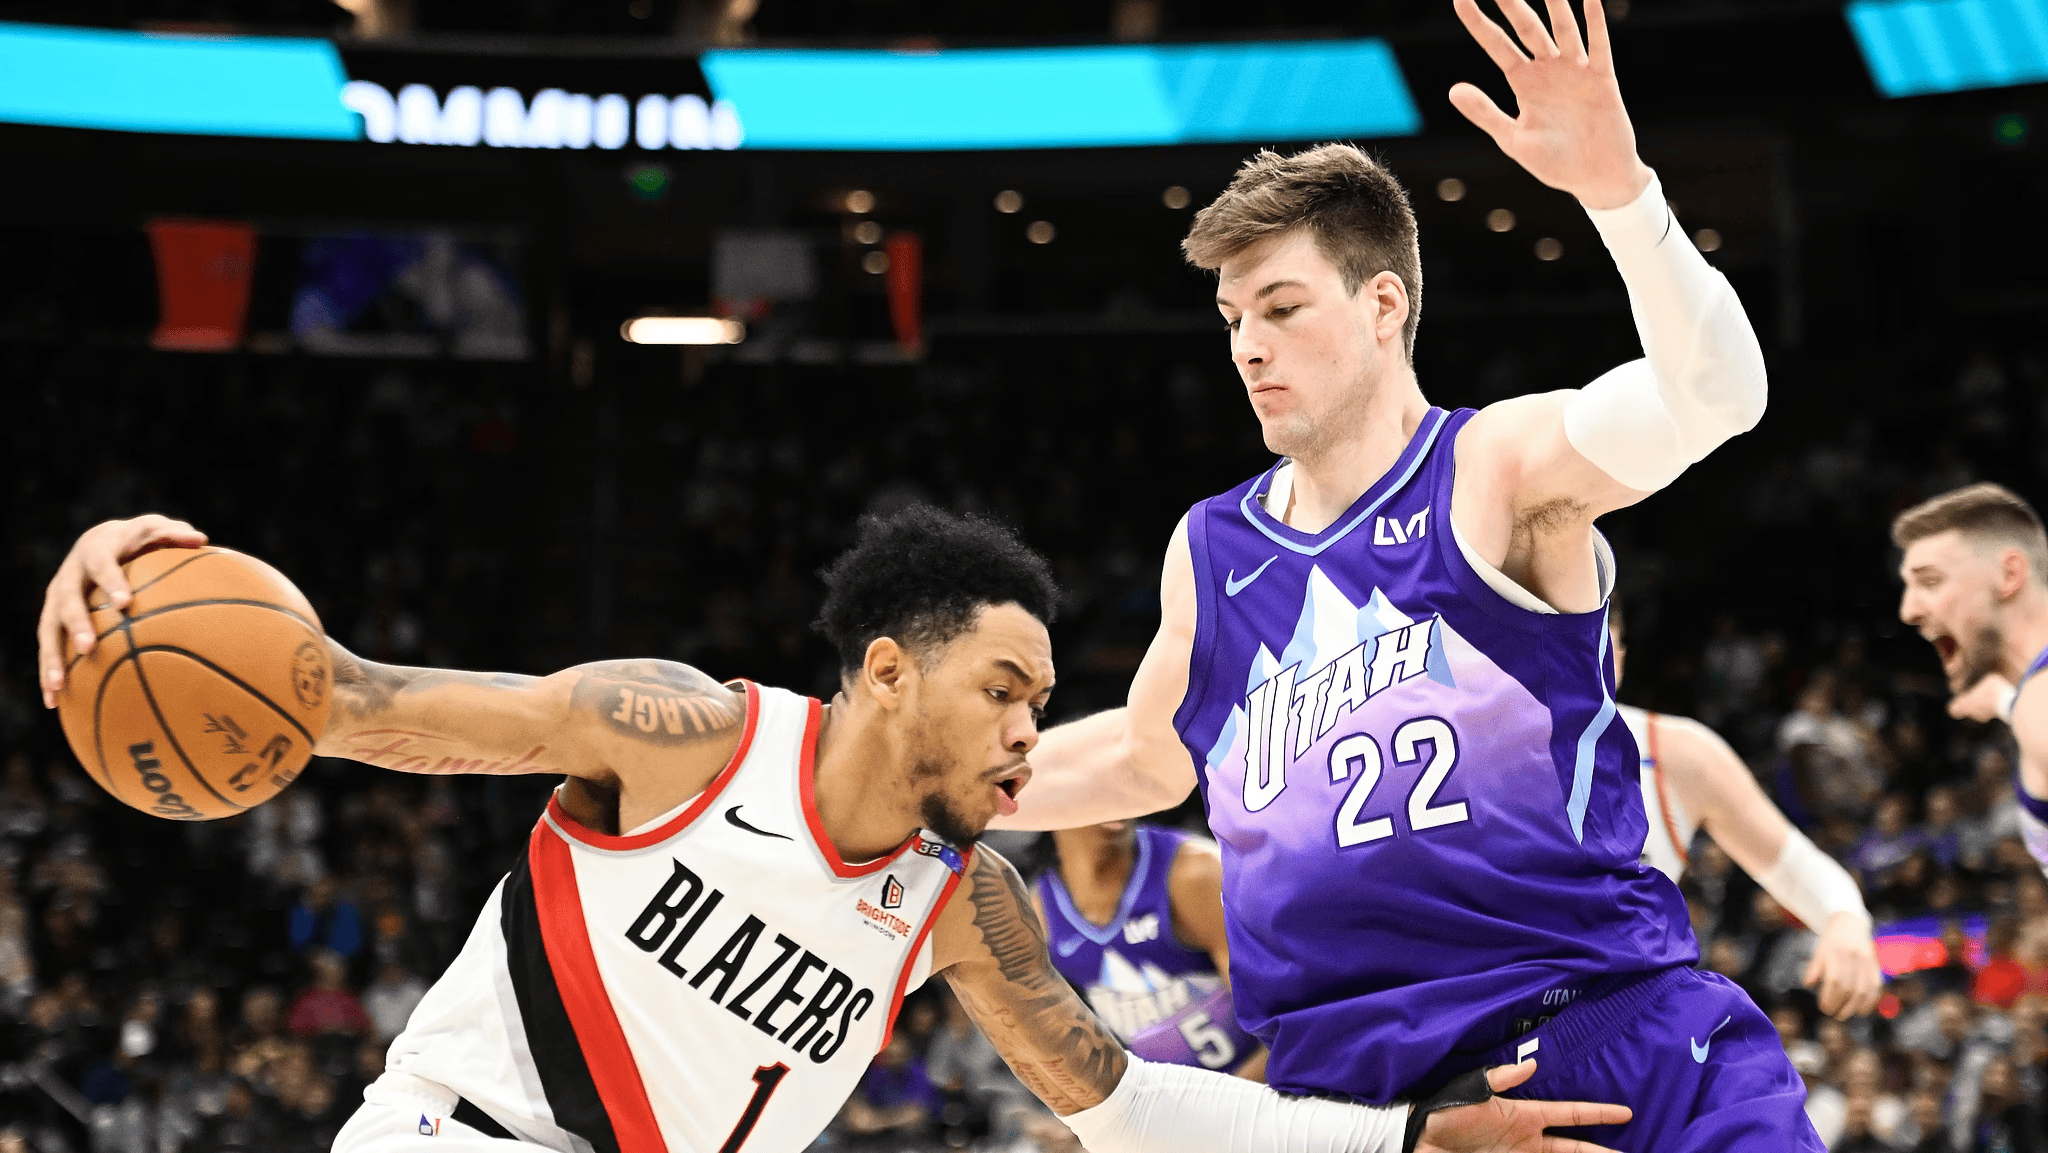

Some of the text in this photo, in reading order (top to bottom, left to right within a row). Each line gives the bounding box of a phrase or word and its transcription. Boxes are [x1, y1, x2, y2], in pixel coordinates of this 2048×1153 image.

[1242, 615, 1439, 812] UTAH
[1328, 715, 1473, 850] 22
[918, 841, 942, 856] 32
[624, 857, 875, 1064] BLAZERS
[1179, 1010, 1235, 1068] 5
[717, 1061, 791, 1153] 1
